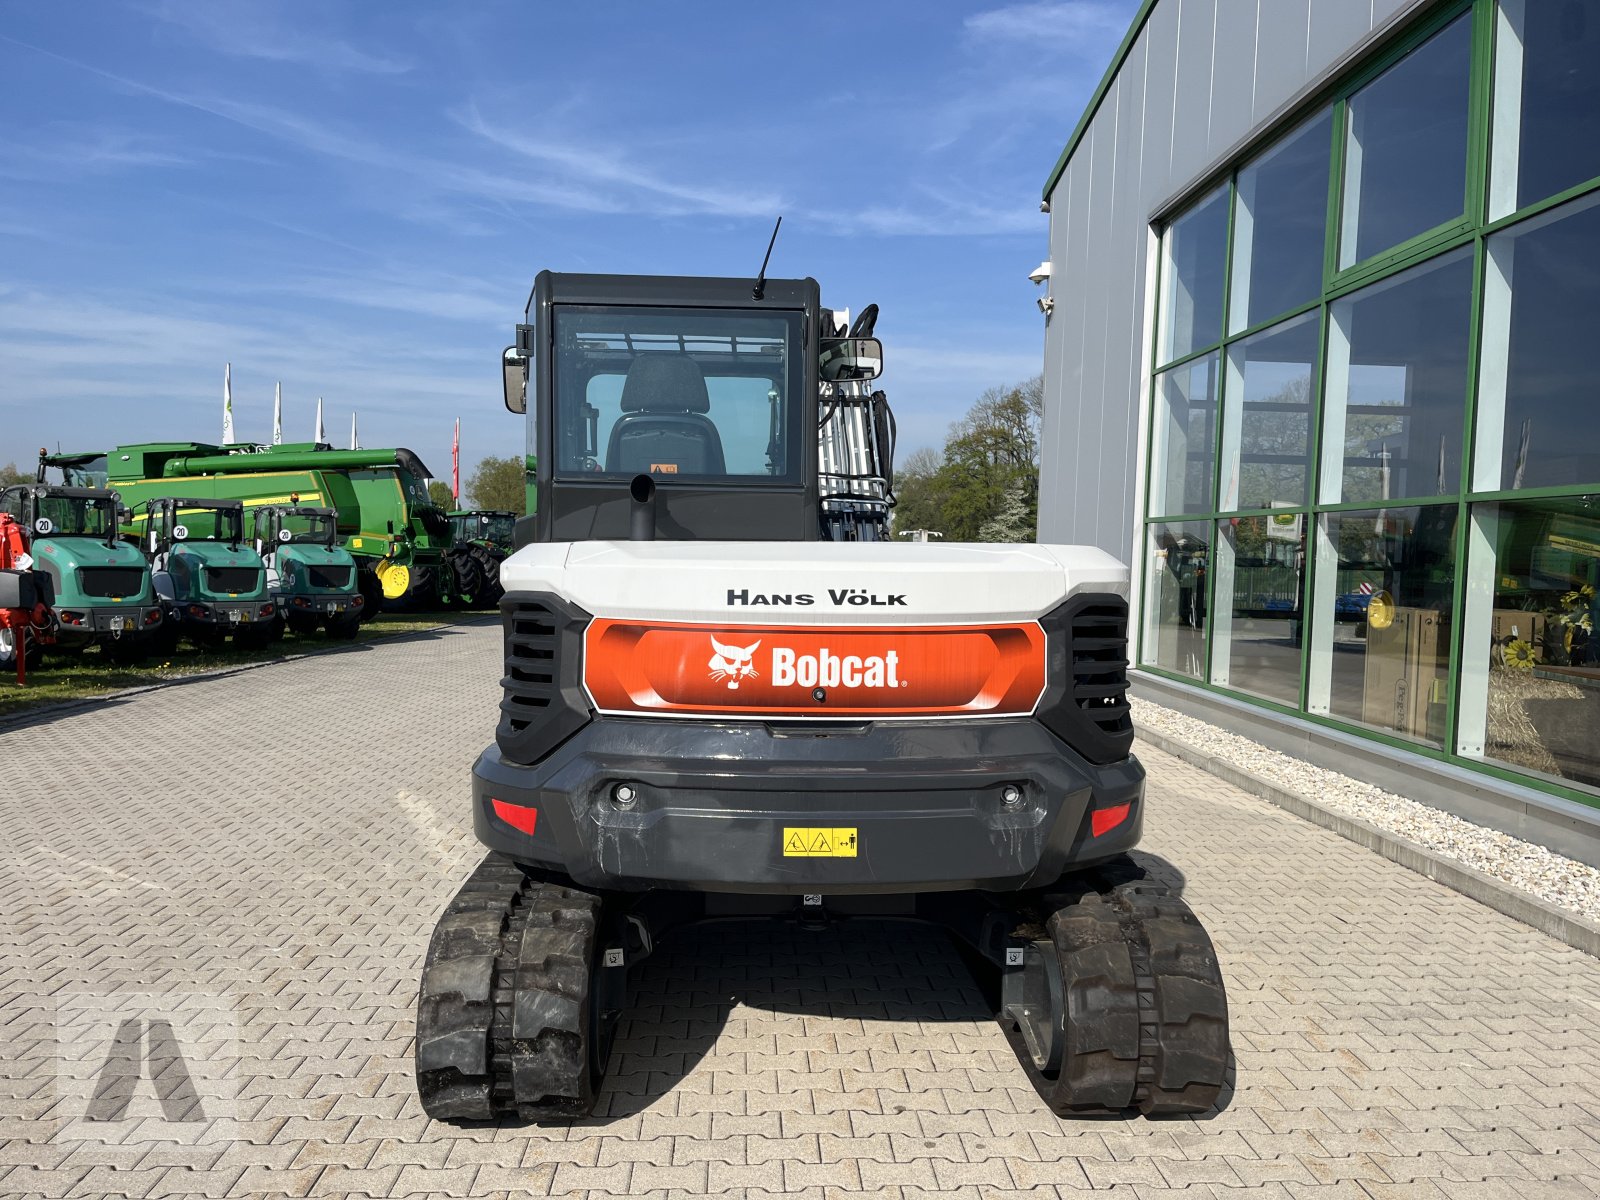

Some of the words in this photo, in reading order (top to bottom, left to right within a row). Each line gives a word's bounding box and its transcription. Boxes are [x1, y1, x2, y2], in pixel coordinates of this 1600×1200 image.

[39, 521, 49, 531] 20
[176, 528, 185, 536] 20
[281, 531, 289, 540] 20
[727, 589, 815, 606] HANS
[828, 589, 908, 606] VÖLK
[772, 648, 899, 688] Bobcat
